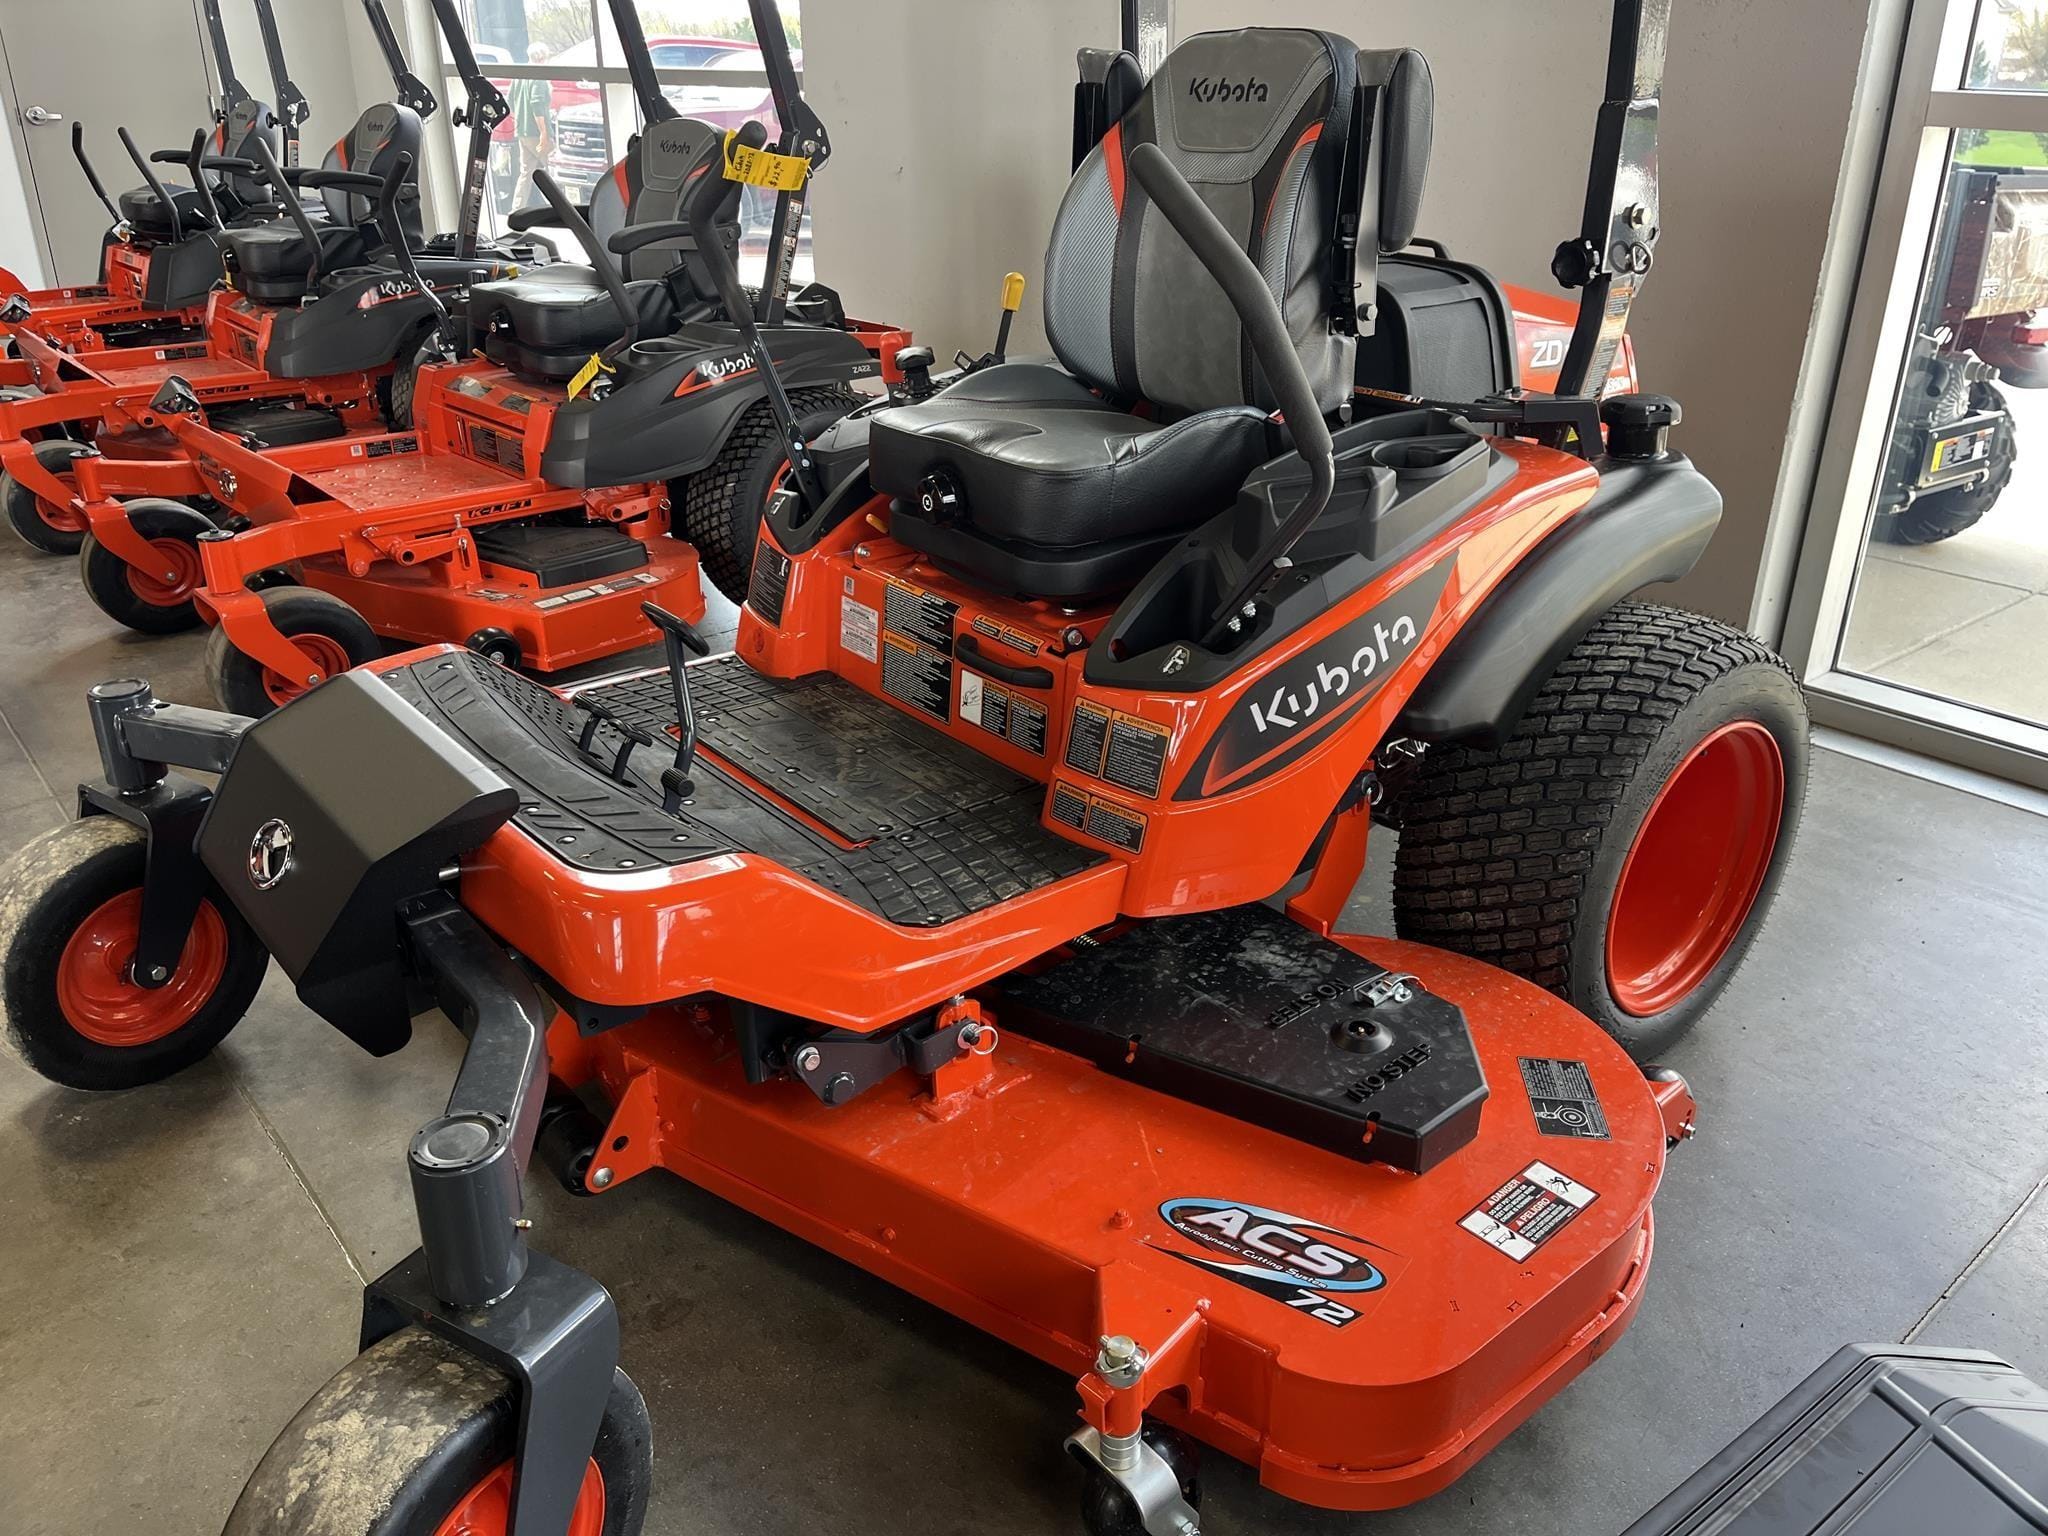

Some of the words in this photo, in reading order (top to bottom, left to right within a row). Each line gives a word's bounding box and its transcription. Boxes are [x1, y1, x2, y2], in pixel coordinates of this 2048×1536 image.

[1189, 76, 1268, 103] Kubota
[660, 139, 690, 154] Kubota
[701, 352, 756, 377] Kubot
[1530, 339, 1572, 369] ZD
[470, 499, 531, 518] K-LIFT
[1249, 614, 1417, 733] Kubota
[1085, 701, 1108, 715] WARNING
[1126, 716, 1164, 733] ADVERTENCIA
[1101, 801, 1141, 822] ADVERTENCIA
[1348, 1073, 1385, 1103] NO
[1383, 1043, 1432, 1081] STEP
[1492, 1179, 1521, 1203] DANGER
[1521, 1197, 1551, 1225] PELIGRO
[1184, 1206, 1358, 1276] ACS
[1174, 1221, 1241, 1253] Aerodynamic
[1242, 1249, 1284, 1272] Cutting
[1285, 1267, 1328, 1290] System
[1285, 1288, 1355, 1326] 72
